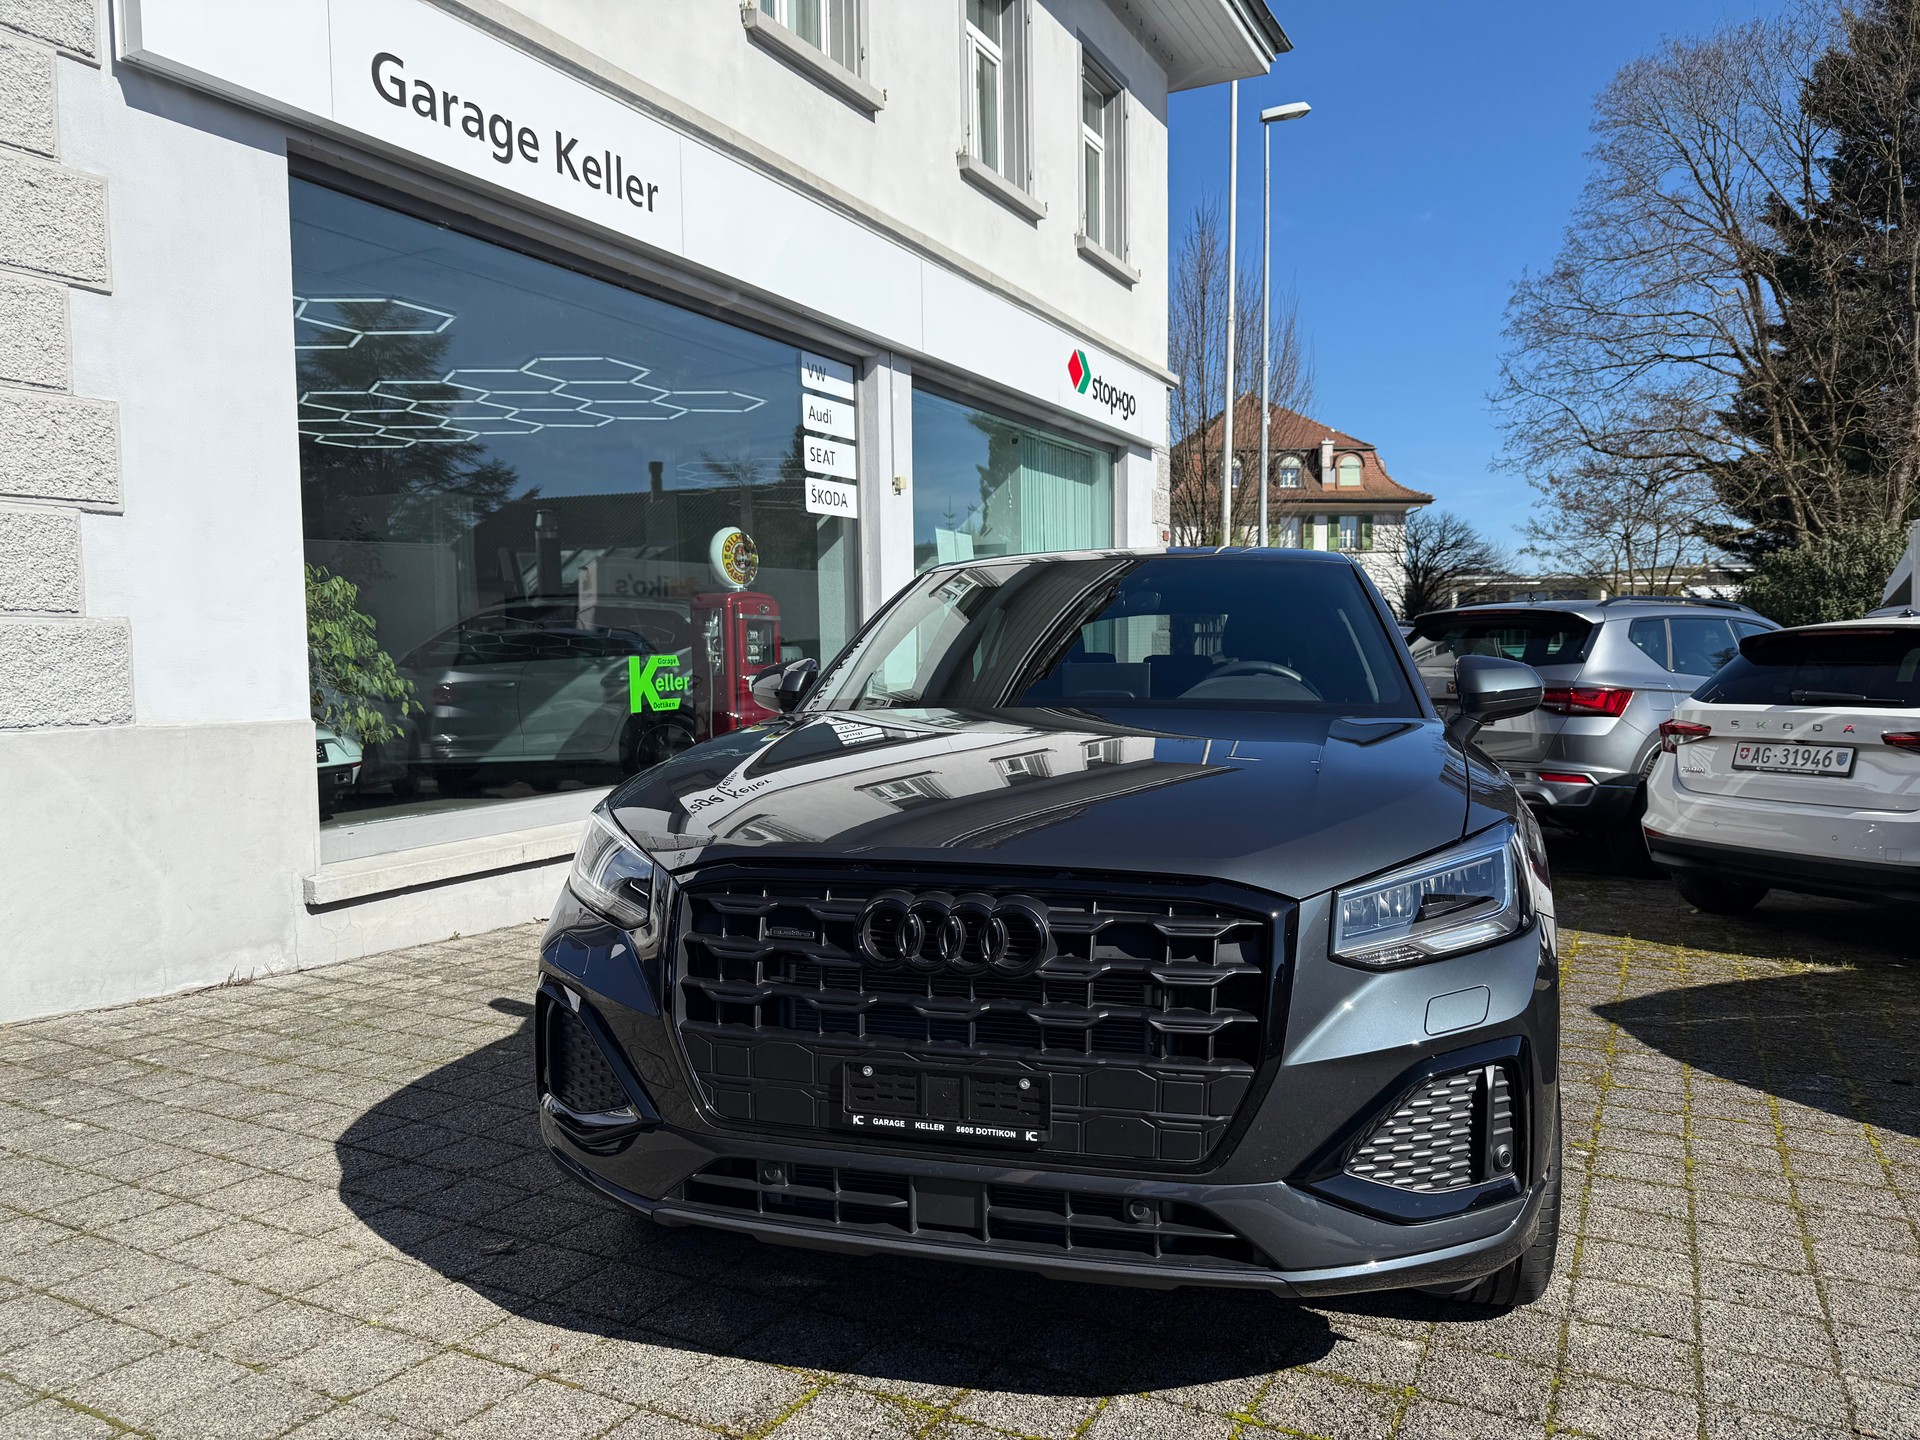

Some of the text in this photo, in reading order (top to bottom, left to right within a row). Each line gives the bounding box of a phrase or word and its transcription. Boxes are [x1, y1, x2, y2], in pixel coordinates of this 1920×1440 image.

[371, 52, 658, 212] Garage Keller
[806, 362, 827, 382] VW
[1092, 375, 1136, 420] stop+go
[809, 406, 832, 425] Audi
[810, 447, 836, 466] SEAT
[811, 485, 848, 508] ŠKODA
[629, 655, 690, 713] Keller
[872, 1118, 905, 1128] GARAGE
[915, 1122, 944, 1131] KELLER
[956, 1126, 974, 1134] 5605
[975, 1127, 1016, 1138] DOTTIKON
